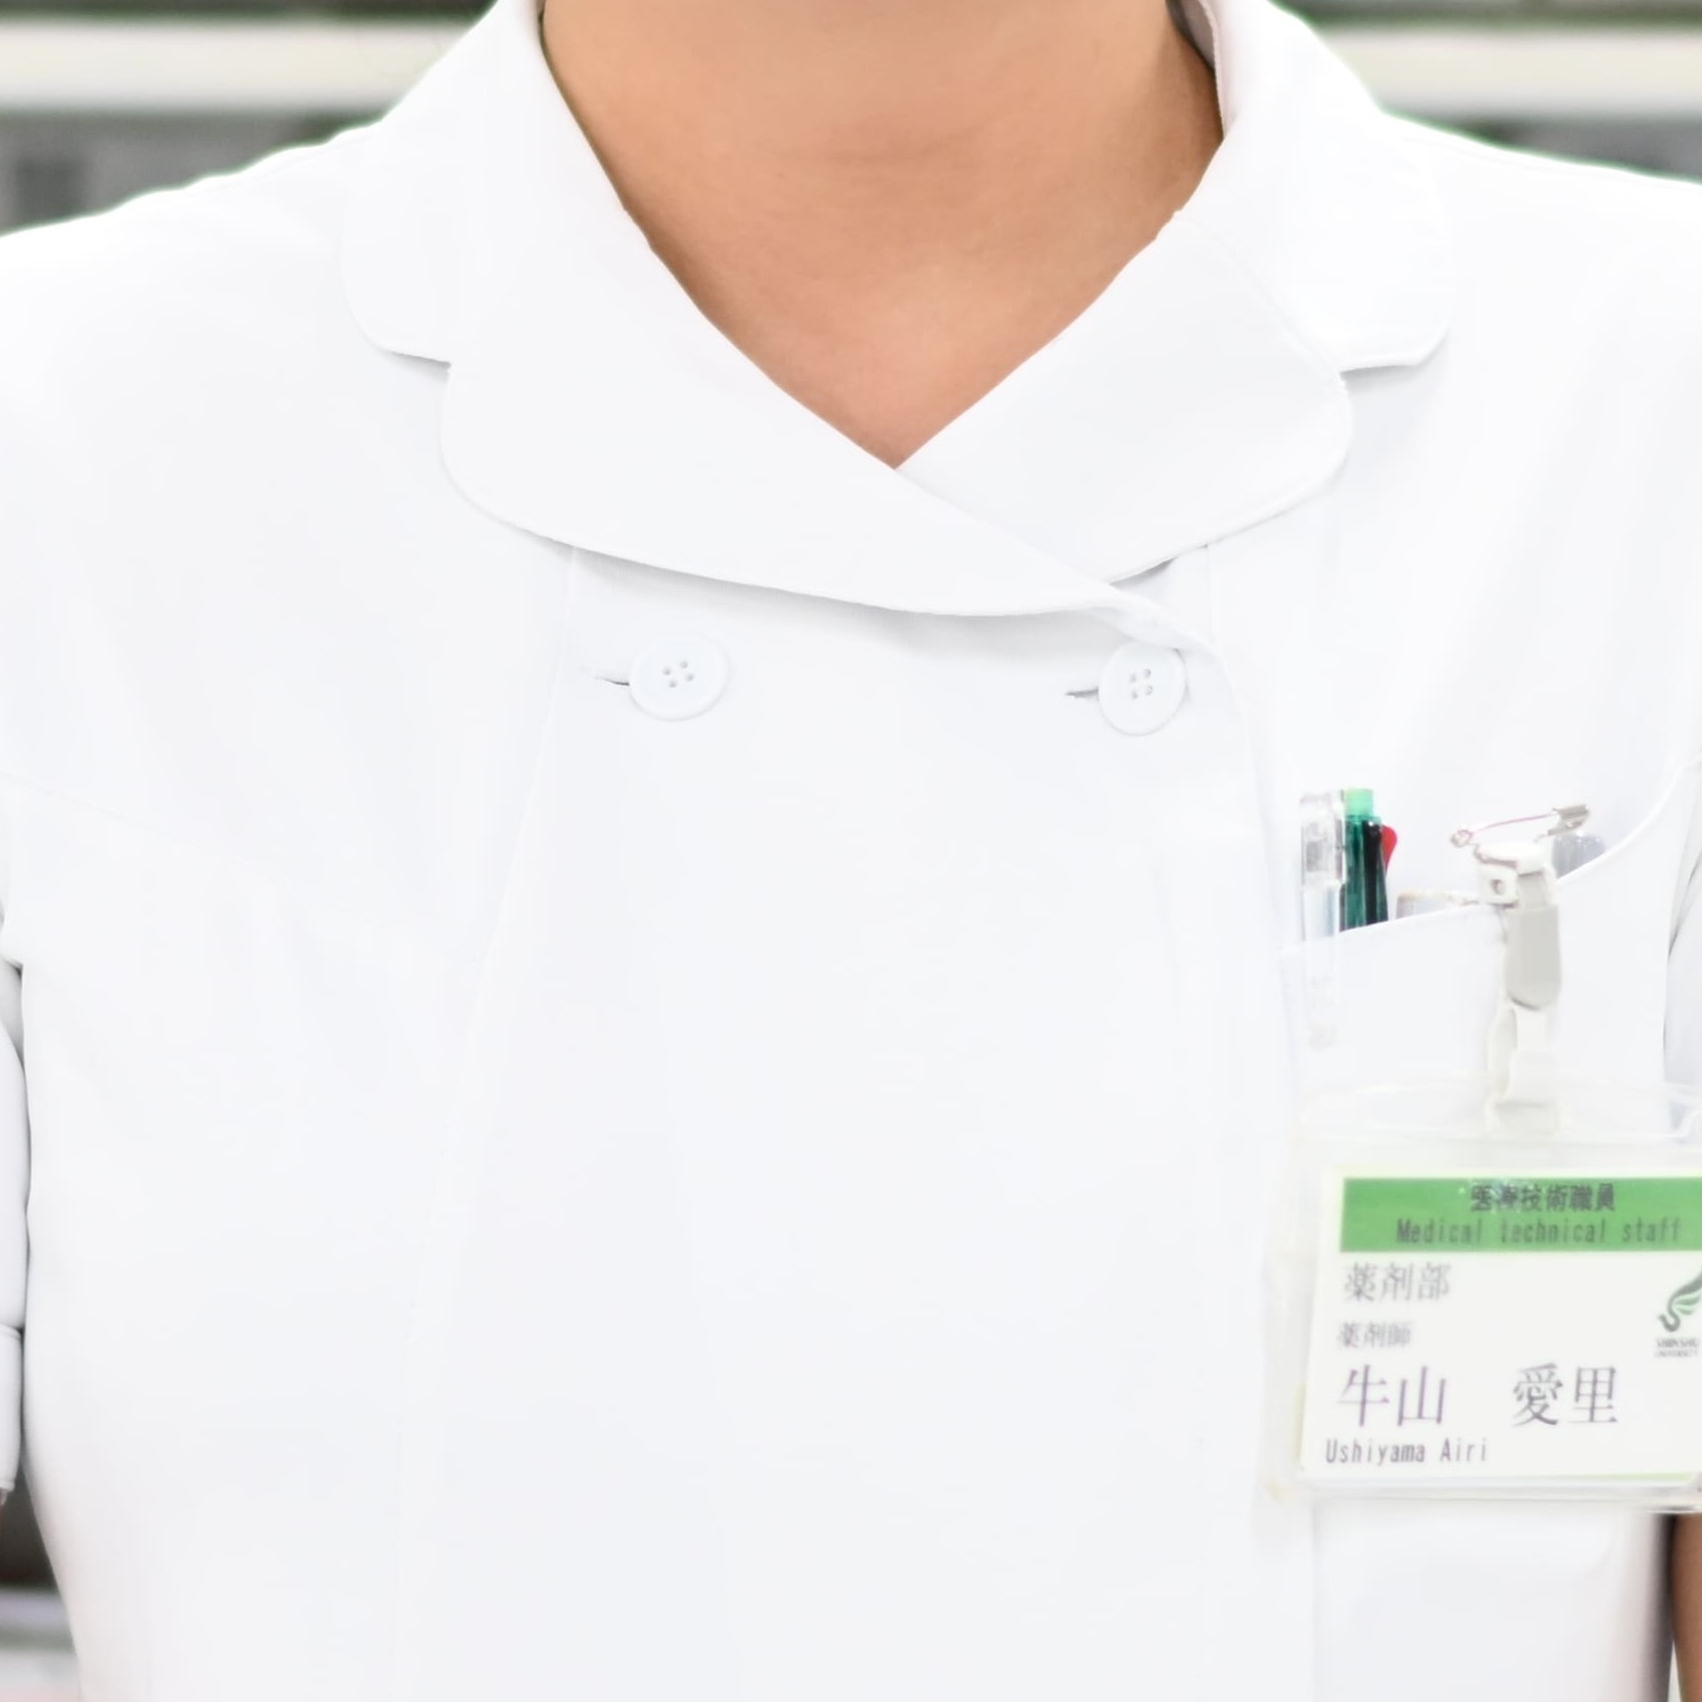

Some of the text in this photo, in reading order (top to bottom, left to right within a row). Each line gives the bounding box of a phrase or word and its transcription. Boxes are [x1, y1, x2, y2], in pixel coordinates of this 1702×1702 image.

[1397, 1216, 1682, 1244] Medical technical staff
[1344, 1262, 1451, 1301] 薬剤部
[1339, 1363, 1618, 1427] 牛山 愛里
[1325, 1436, 1487, 1466] Ushiyama Airi
